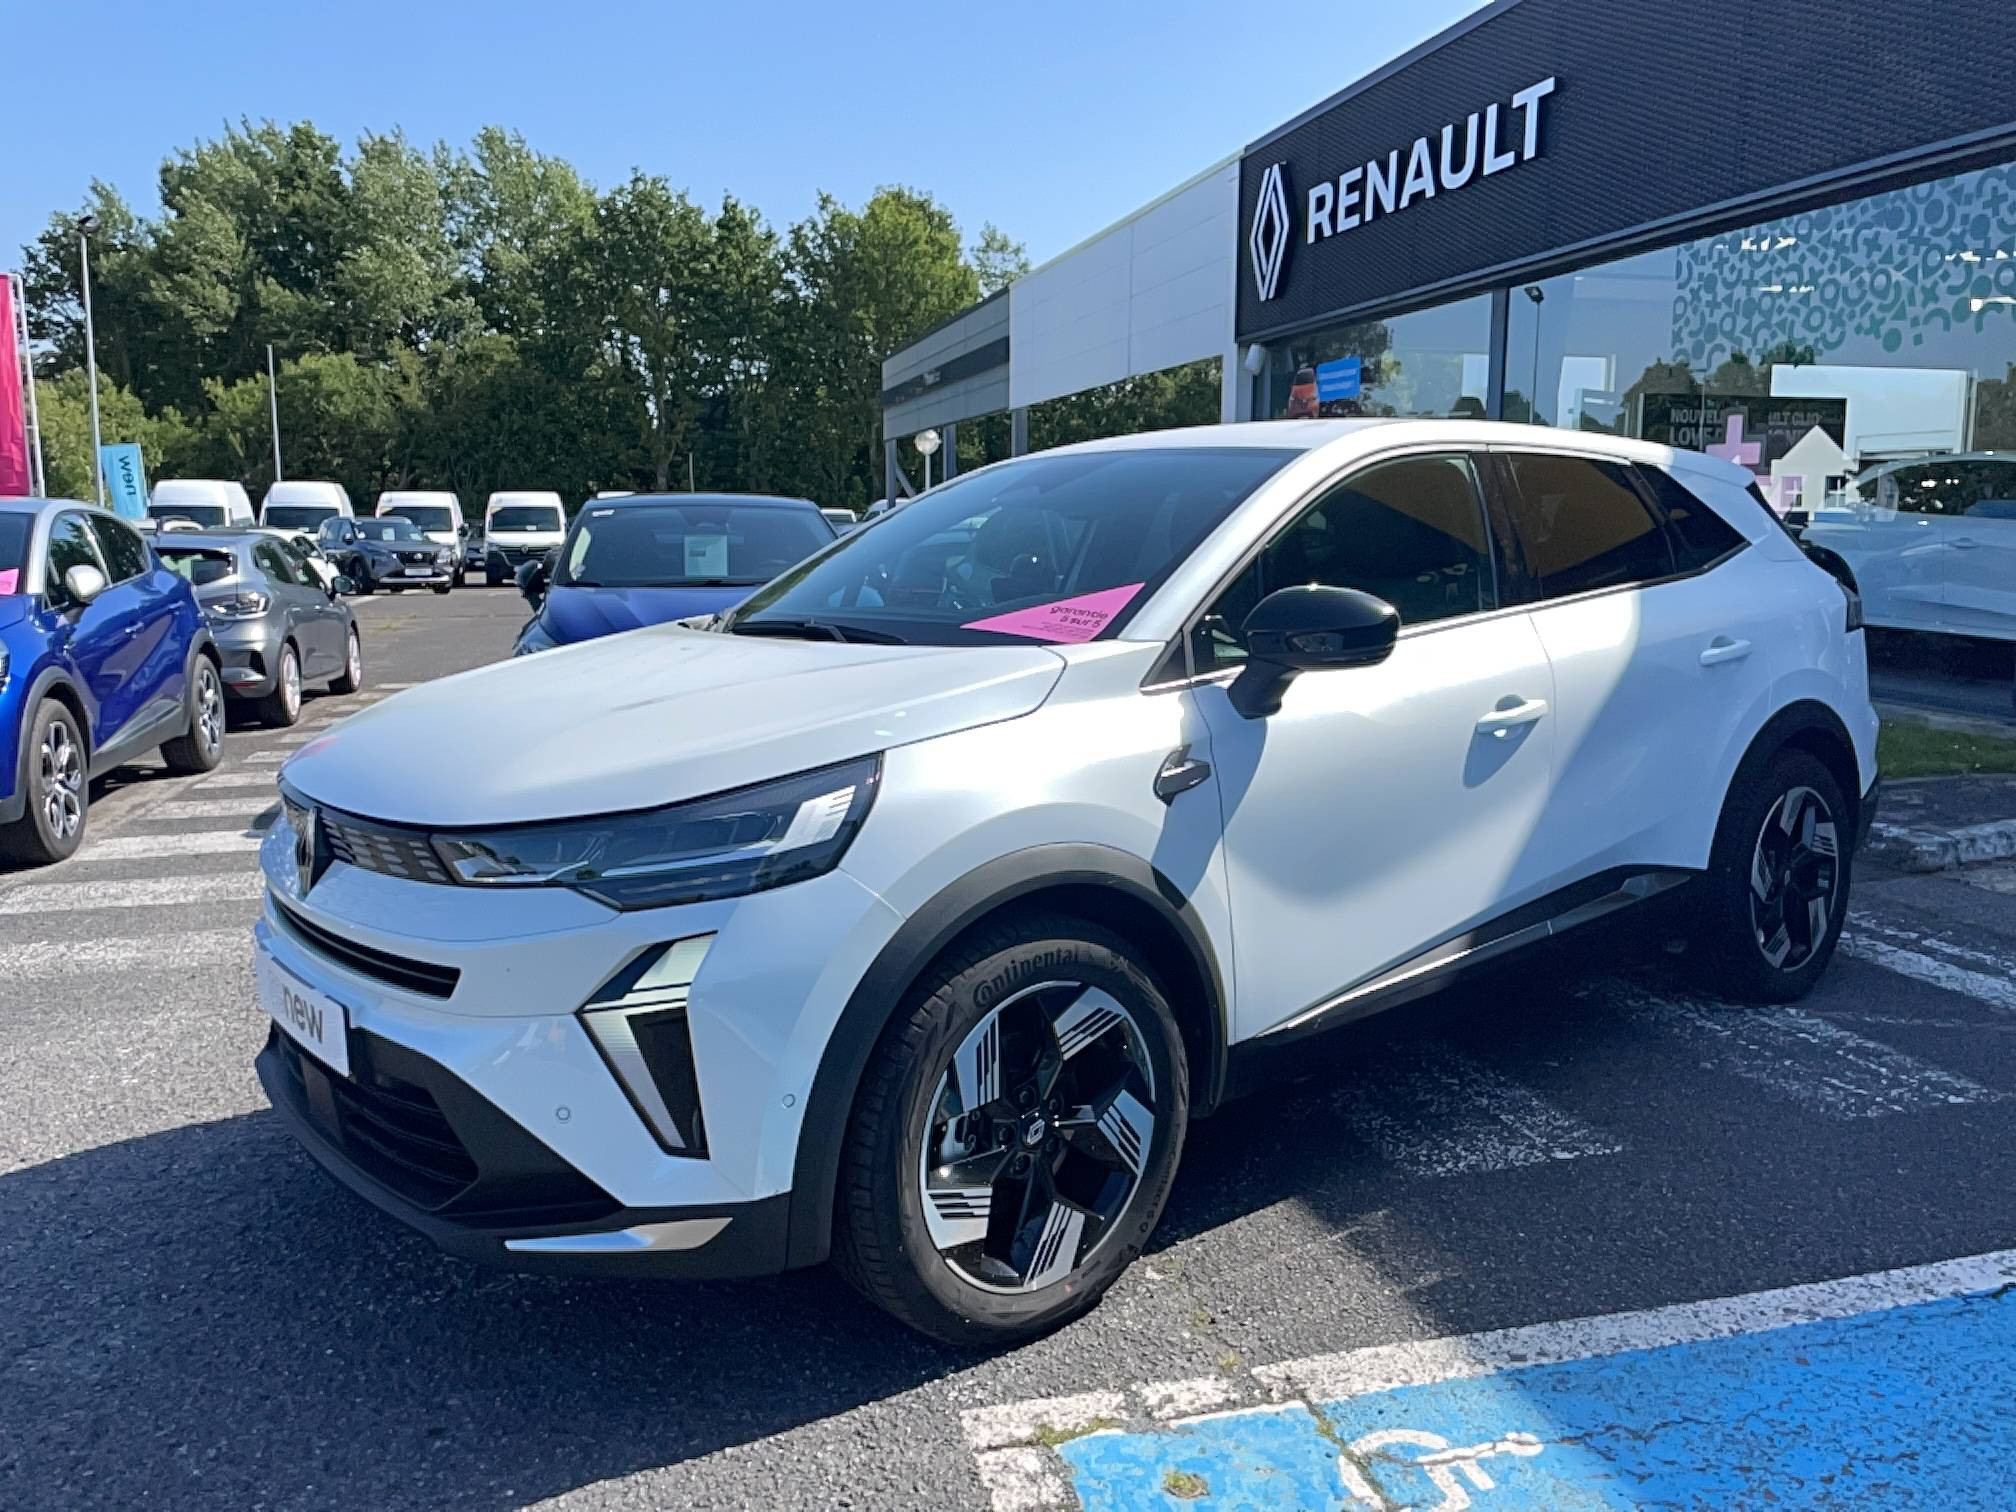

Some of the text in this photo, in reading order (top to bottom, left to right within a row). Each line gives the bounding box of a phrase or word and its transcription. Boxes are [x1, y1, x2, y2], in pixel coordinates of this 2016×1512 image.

[1306, 76, 1555, 245] RENAULT
[118, 455, 137, 496] new
[1050, 606, 1108, 620] garantie
[973, 944, 1079, 1009] Continental
